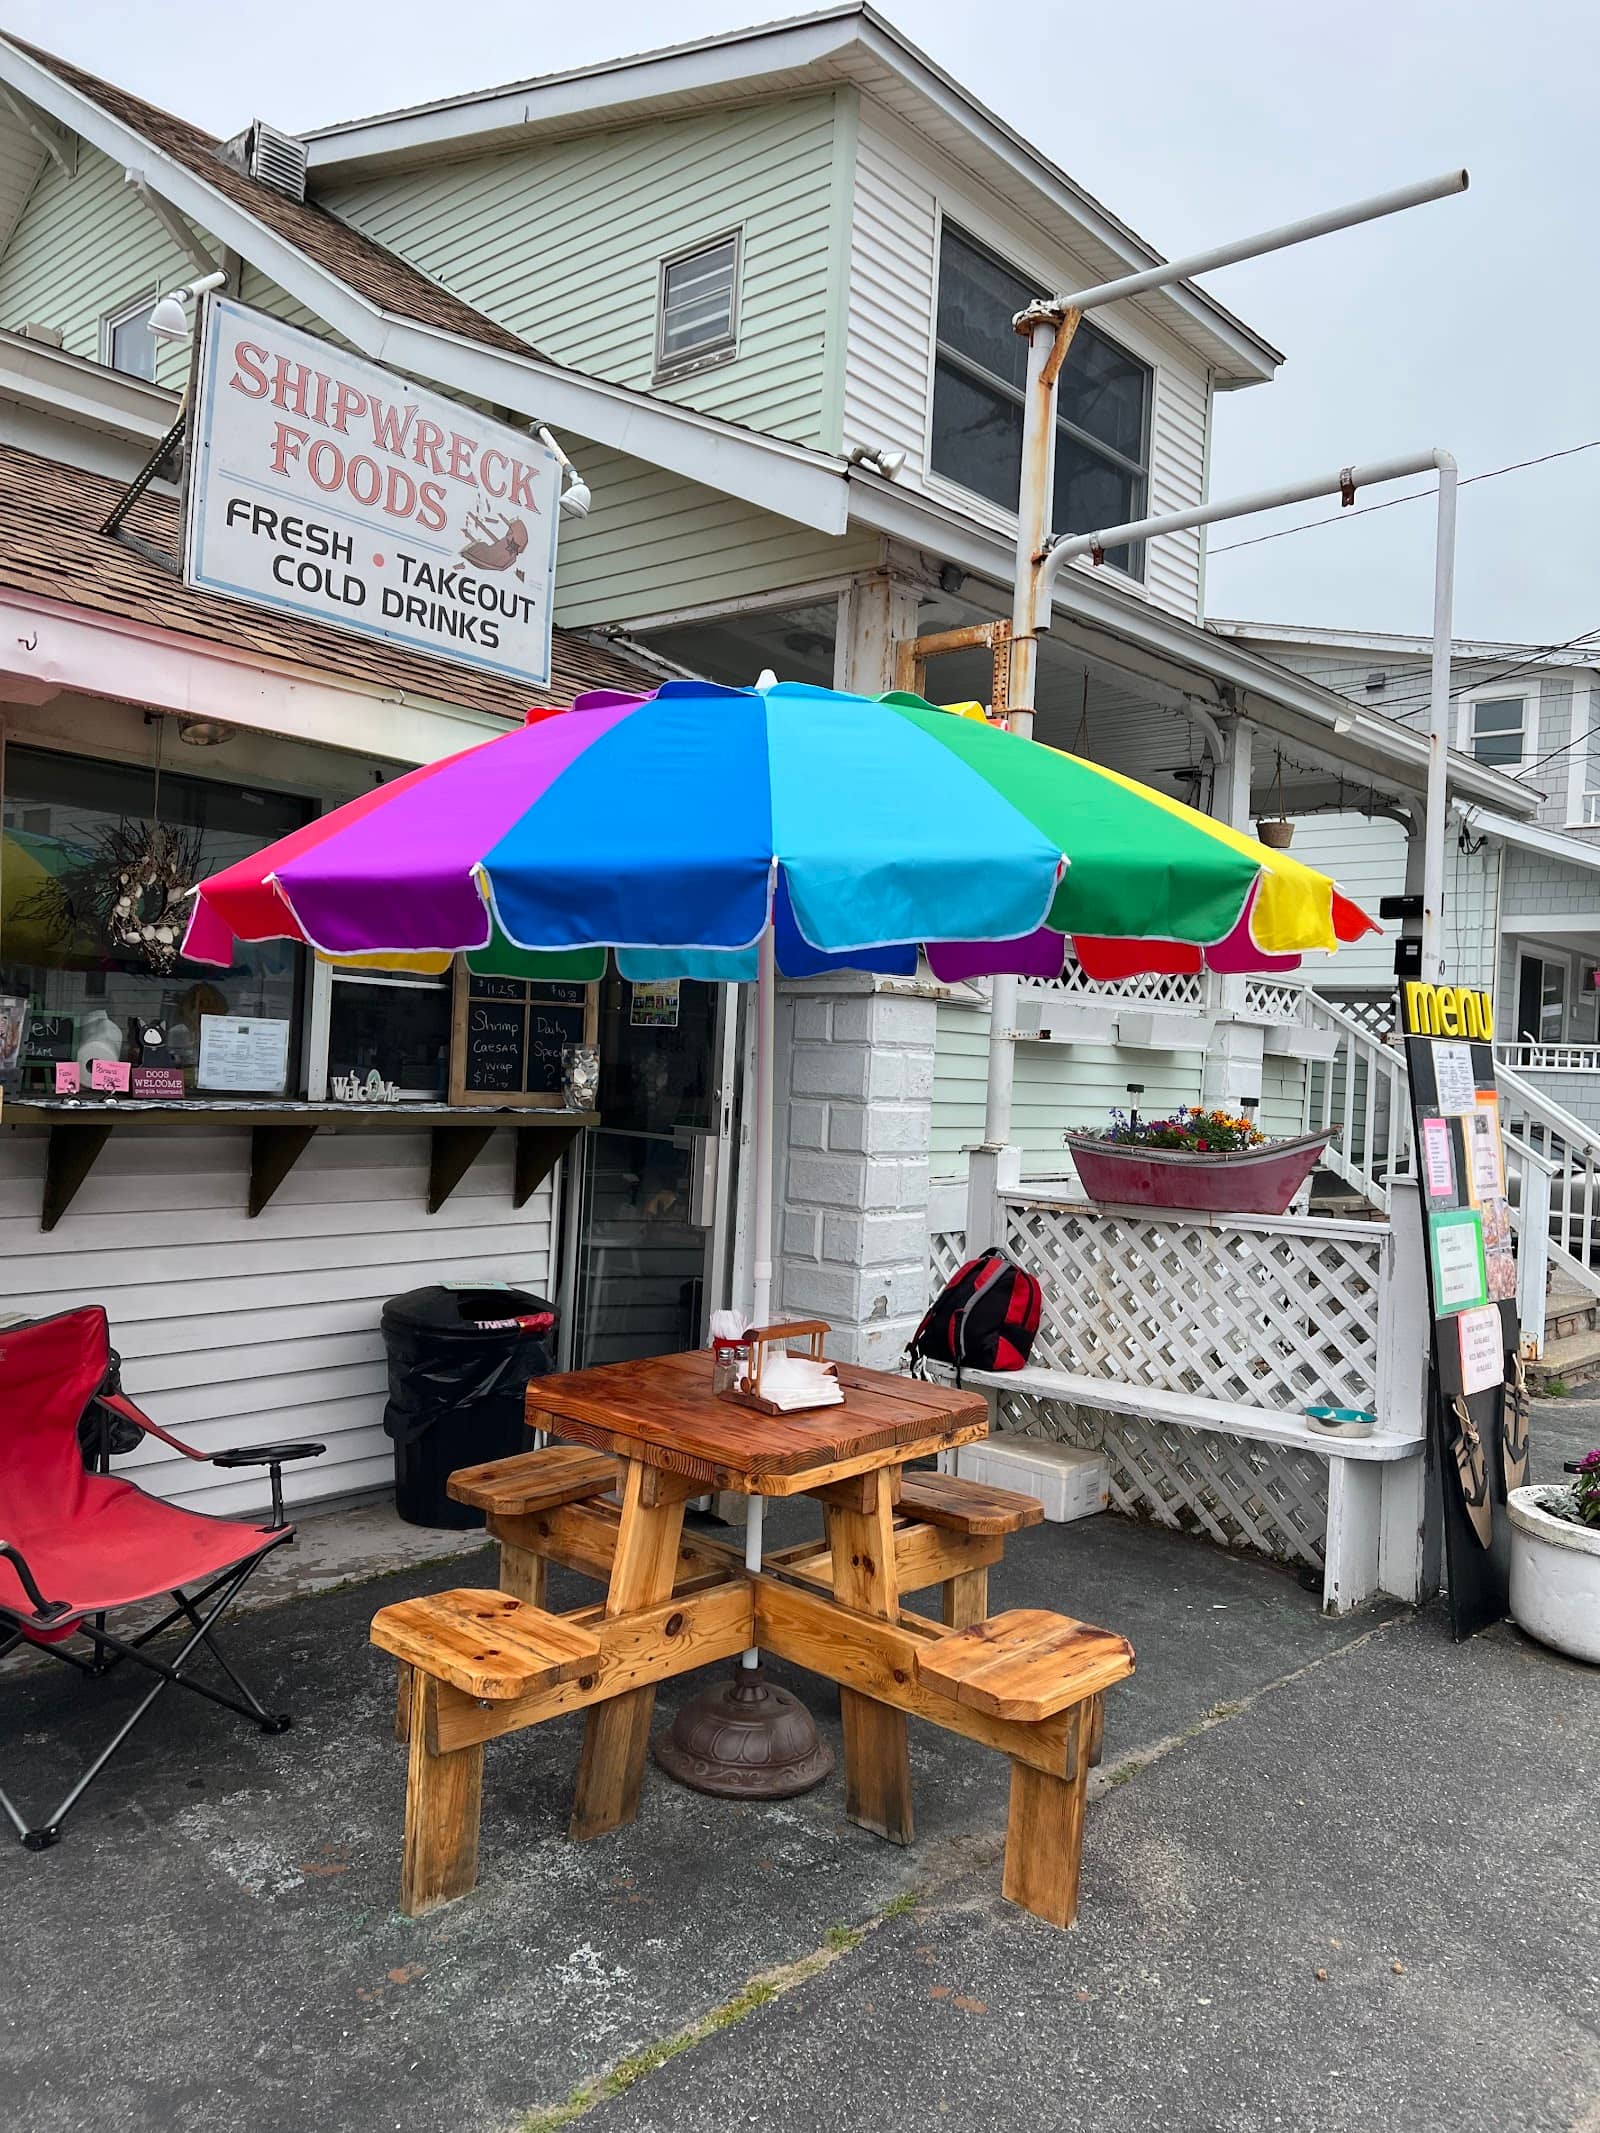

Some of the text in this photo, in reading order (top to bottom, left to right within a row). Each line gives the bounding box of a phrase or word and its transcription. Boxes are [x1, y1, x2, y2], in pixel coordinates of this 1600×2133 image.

[229, 340, 543, 515] SHIPWRECK
[270, 421, 448, 531] FOODS
[225, 497, 536, 625] FRESH TAKEOUT
[273, 554, 500, 650] COLD DRINKS
[471, 1009, 519, 1037] Shrimp
[536, 1016, 568, 1041] Daily
[1406, 981, 1493, 1040] menu
[134, 1079, 183, 1088] WELCOME
[146, 1070, 169, 1078] DOGS
